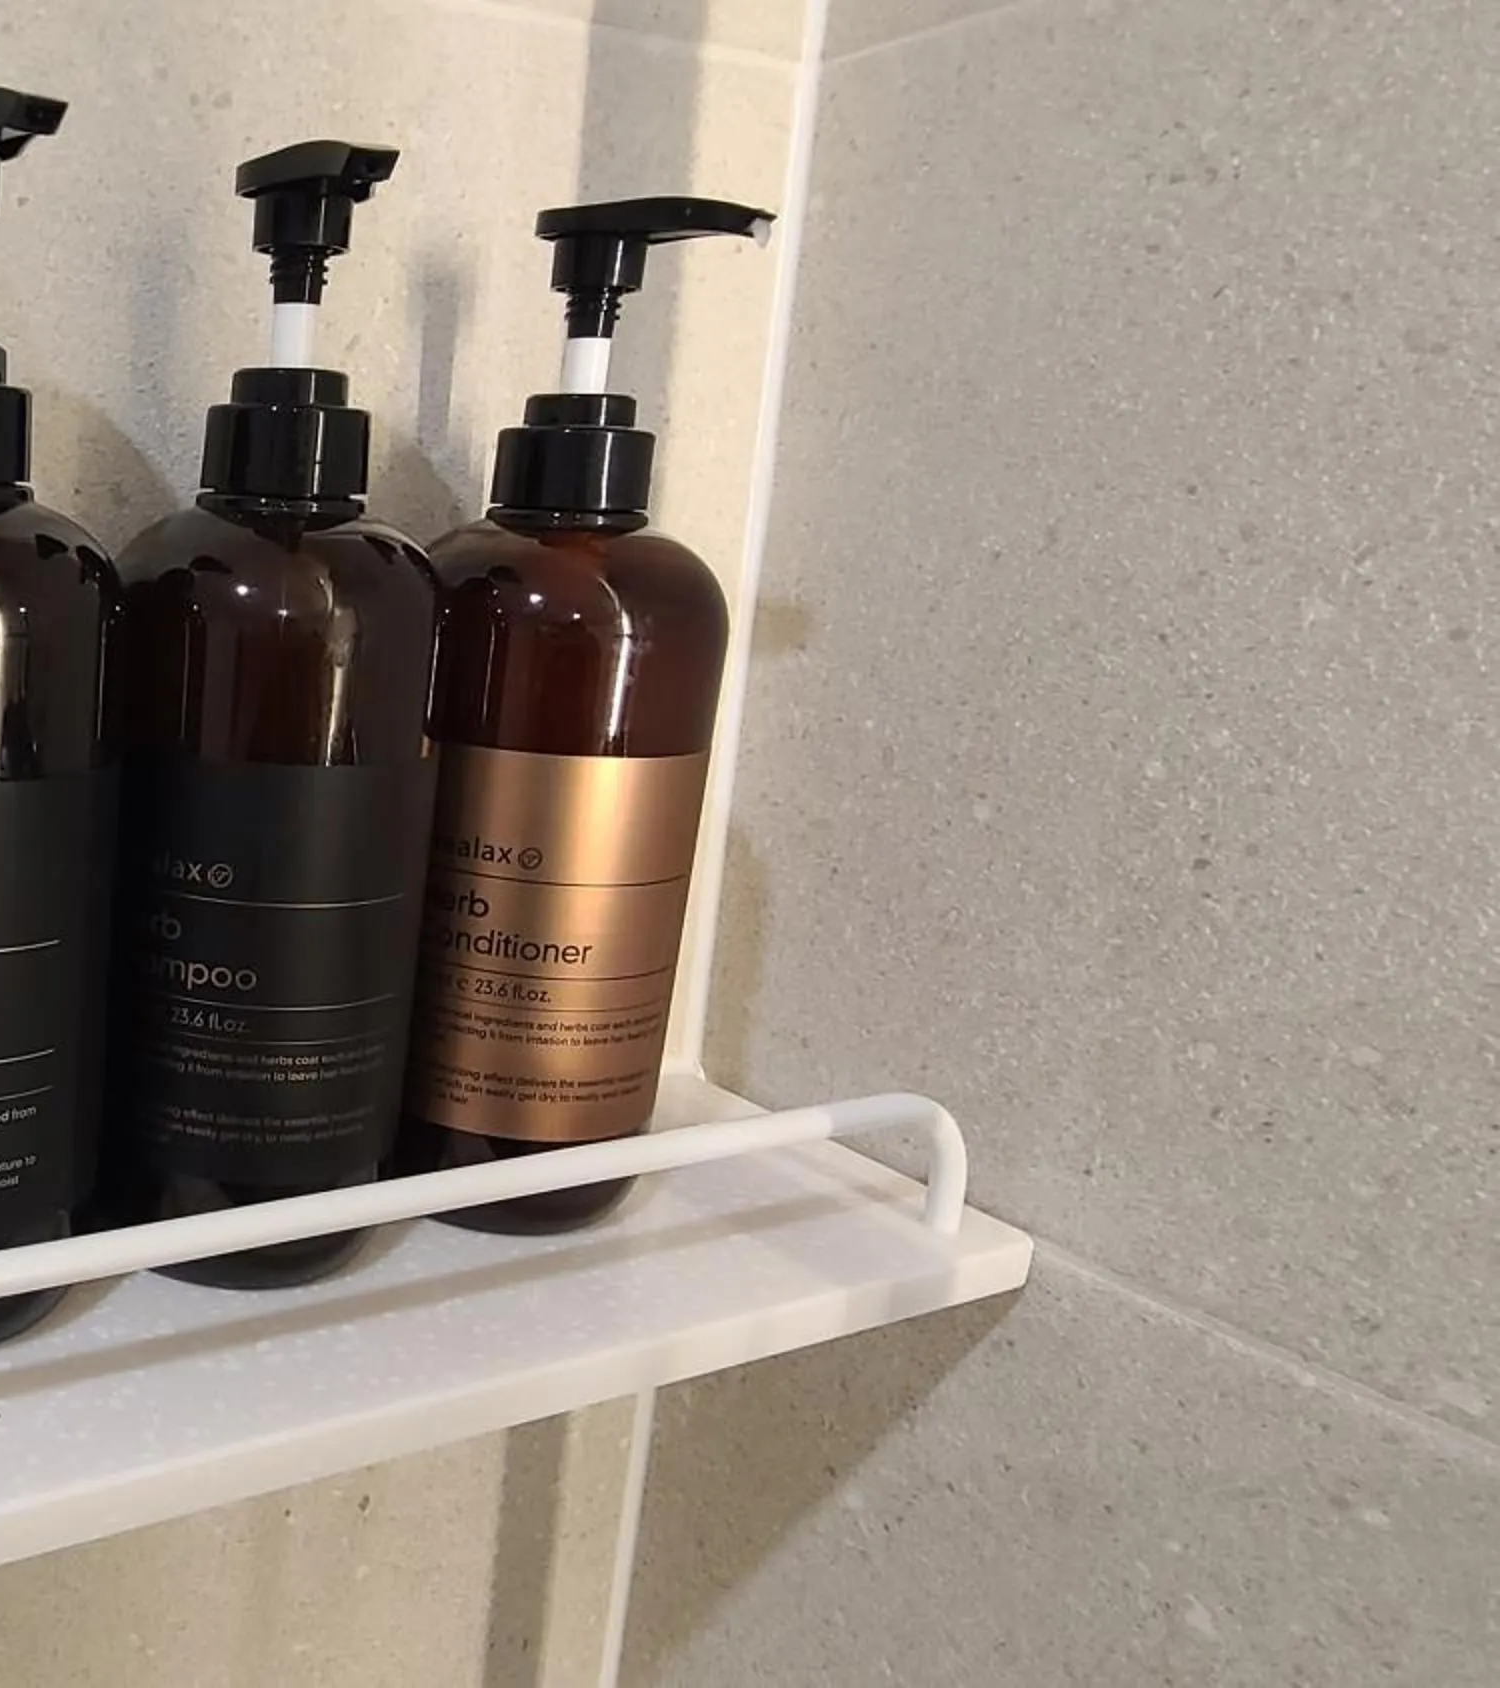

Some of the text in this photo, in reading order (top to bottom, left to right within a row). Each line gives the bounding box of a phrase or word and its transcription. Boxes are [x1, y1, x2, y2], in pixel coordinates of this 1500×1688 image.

[438, 928, 593, 966] onditioner
[474, 977, 508, 999] 23.6
[169, 1006, 205, 1028] 23.6
[536, 1018, 559, 1033] and
[260, 1055, 293, 1067] herbs
[11, 1105, 37, 1120] from
